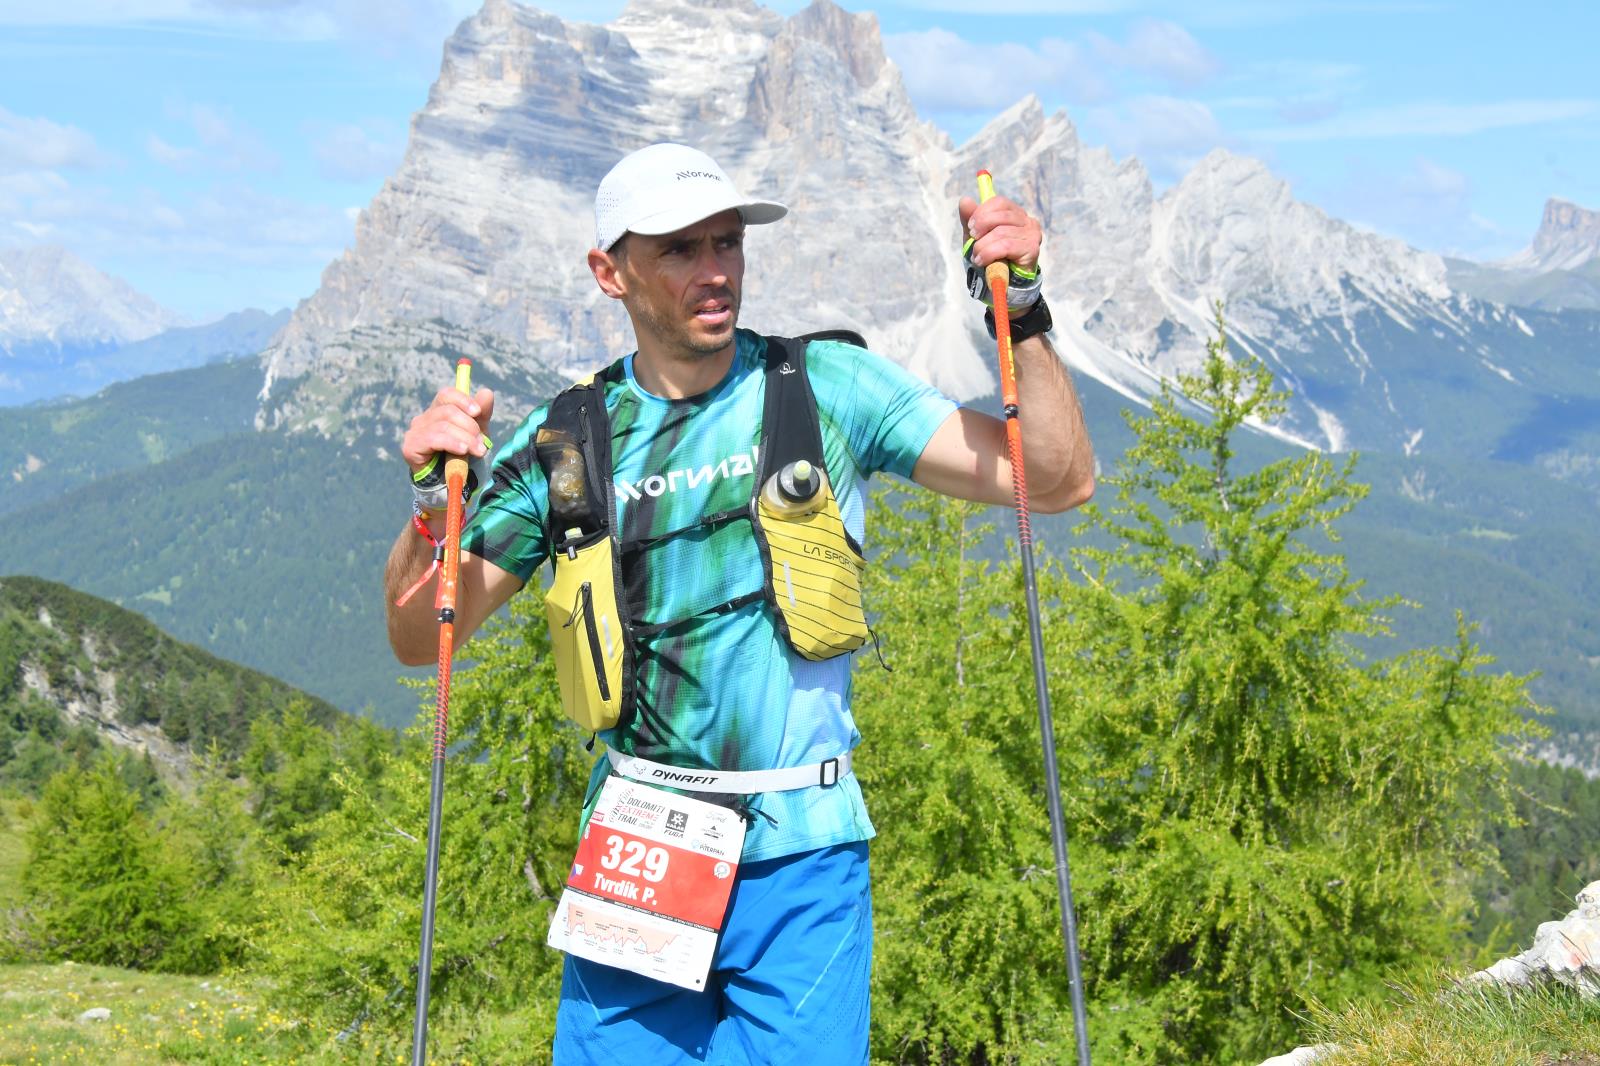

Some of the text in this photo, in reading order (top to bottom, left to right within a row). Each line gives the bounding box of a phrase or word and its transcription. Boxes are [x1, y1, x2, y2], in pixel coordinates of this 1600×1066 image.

[803, 544, 821, 557] LA
[652, 769, 719, 785] DYNAFIT
[621, 805, 660, 822] EXTREME
[627, 797, 666, 814] DOLOMITI
[617, 813, 638, 826] TRAIL
[600, 834, 670, 882] 329
[641, 886, 658, 905] P.
